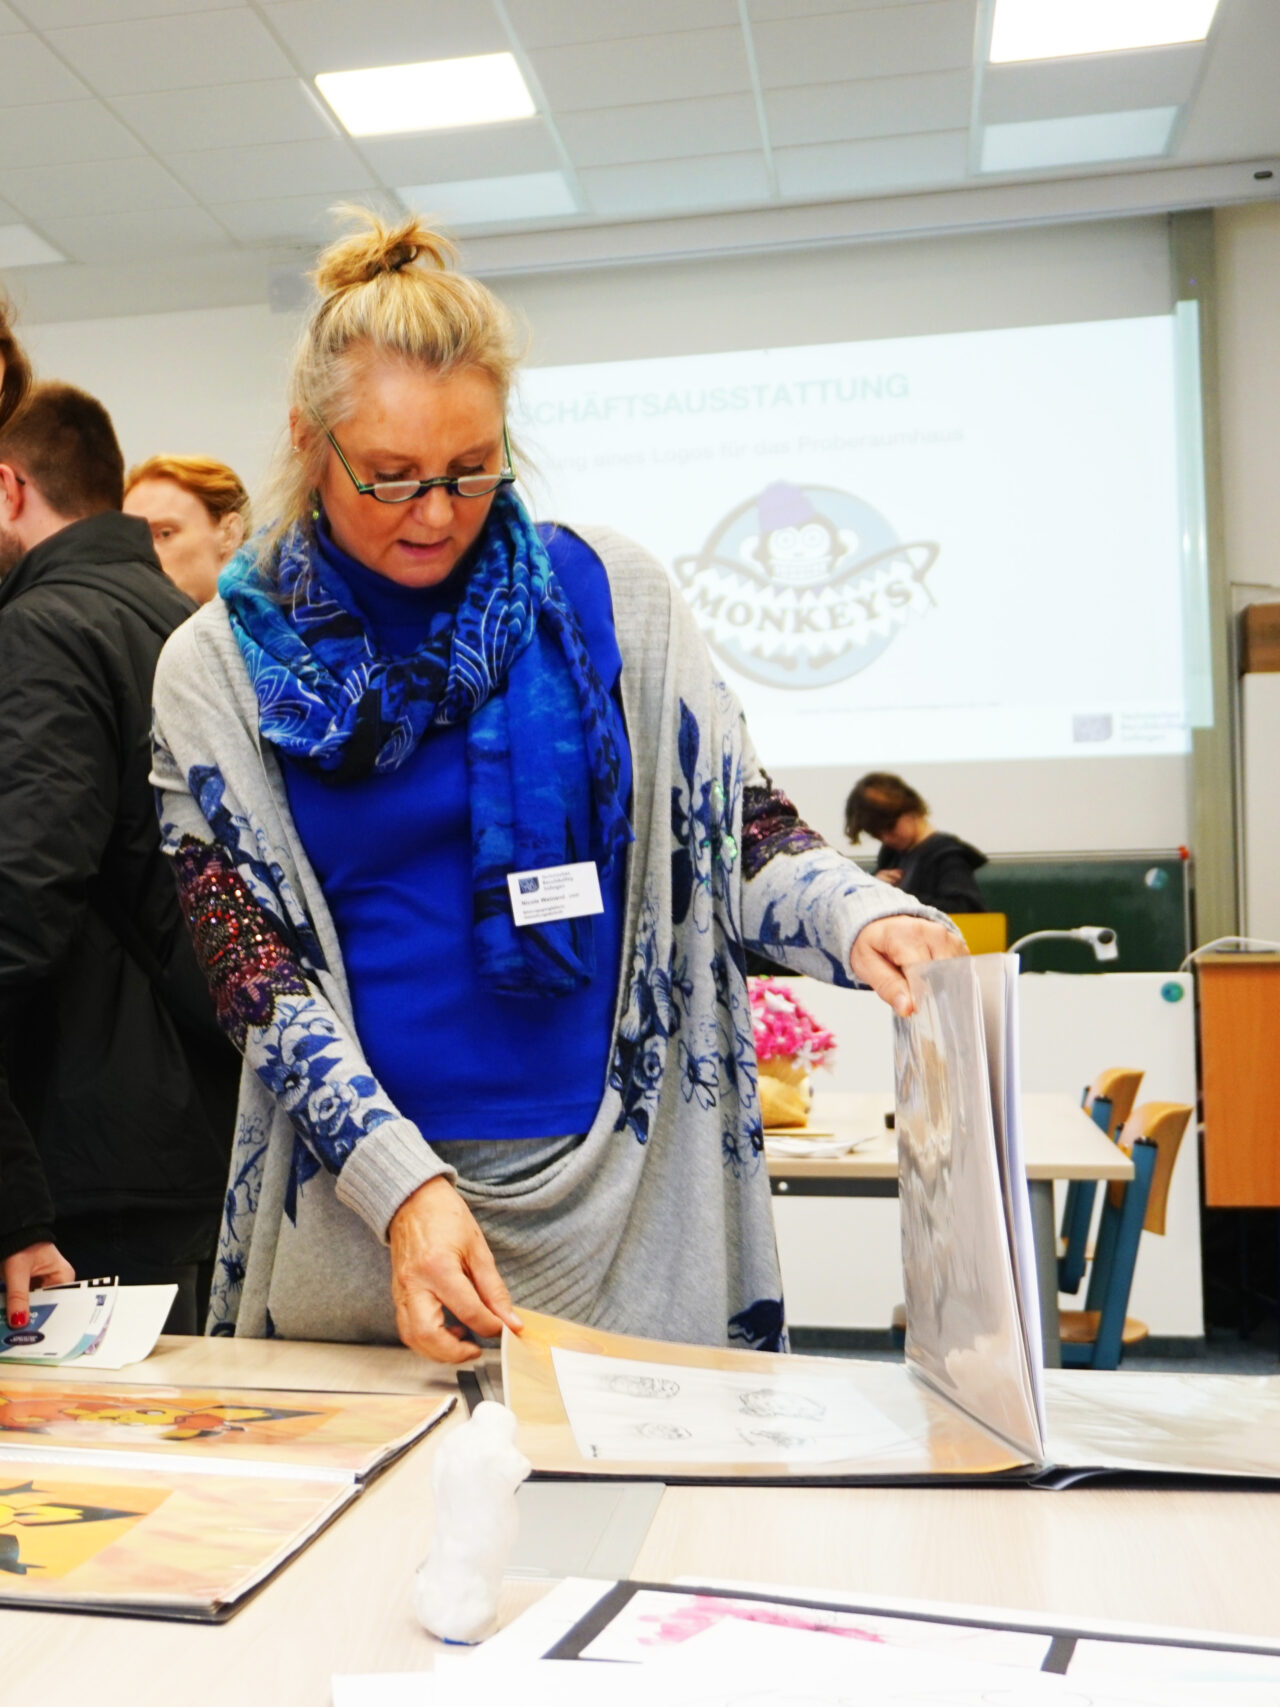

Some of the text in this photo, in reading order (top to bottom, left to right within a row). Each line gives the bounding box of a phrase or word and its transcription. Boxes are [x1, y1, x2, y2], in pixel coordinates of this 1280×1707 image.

[593, 448, 646, 469] eines
[653, 443, 714, 468] Logos
[720, 438, 749, 459] für
[754, 435, 790, 456] das
[797, 425, 965, 453] Proberaumhaus
